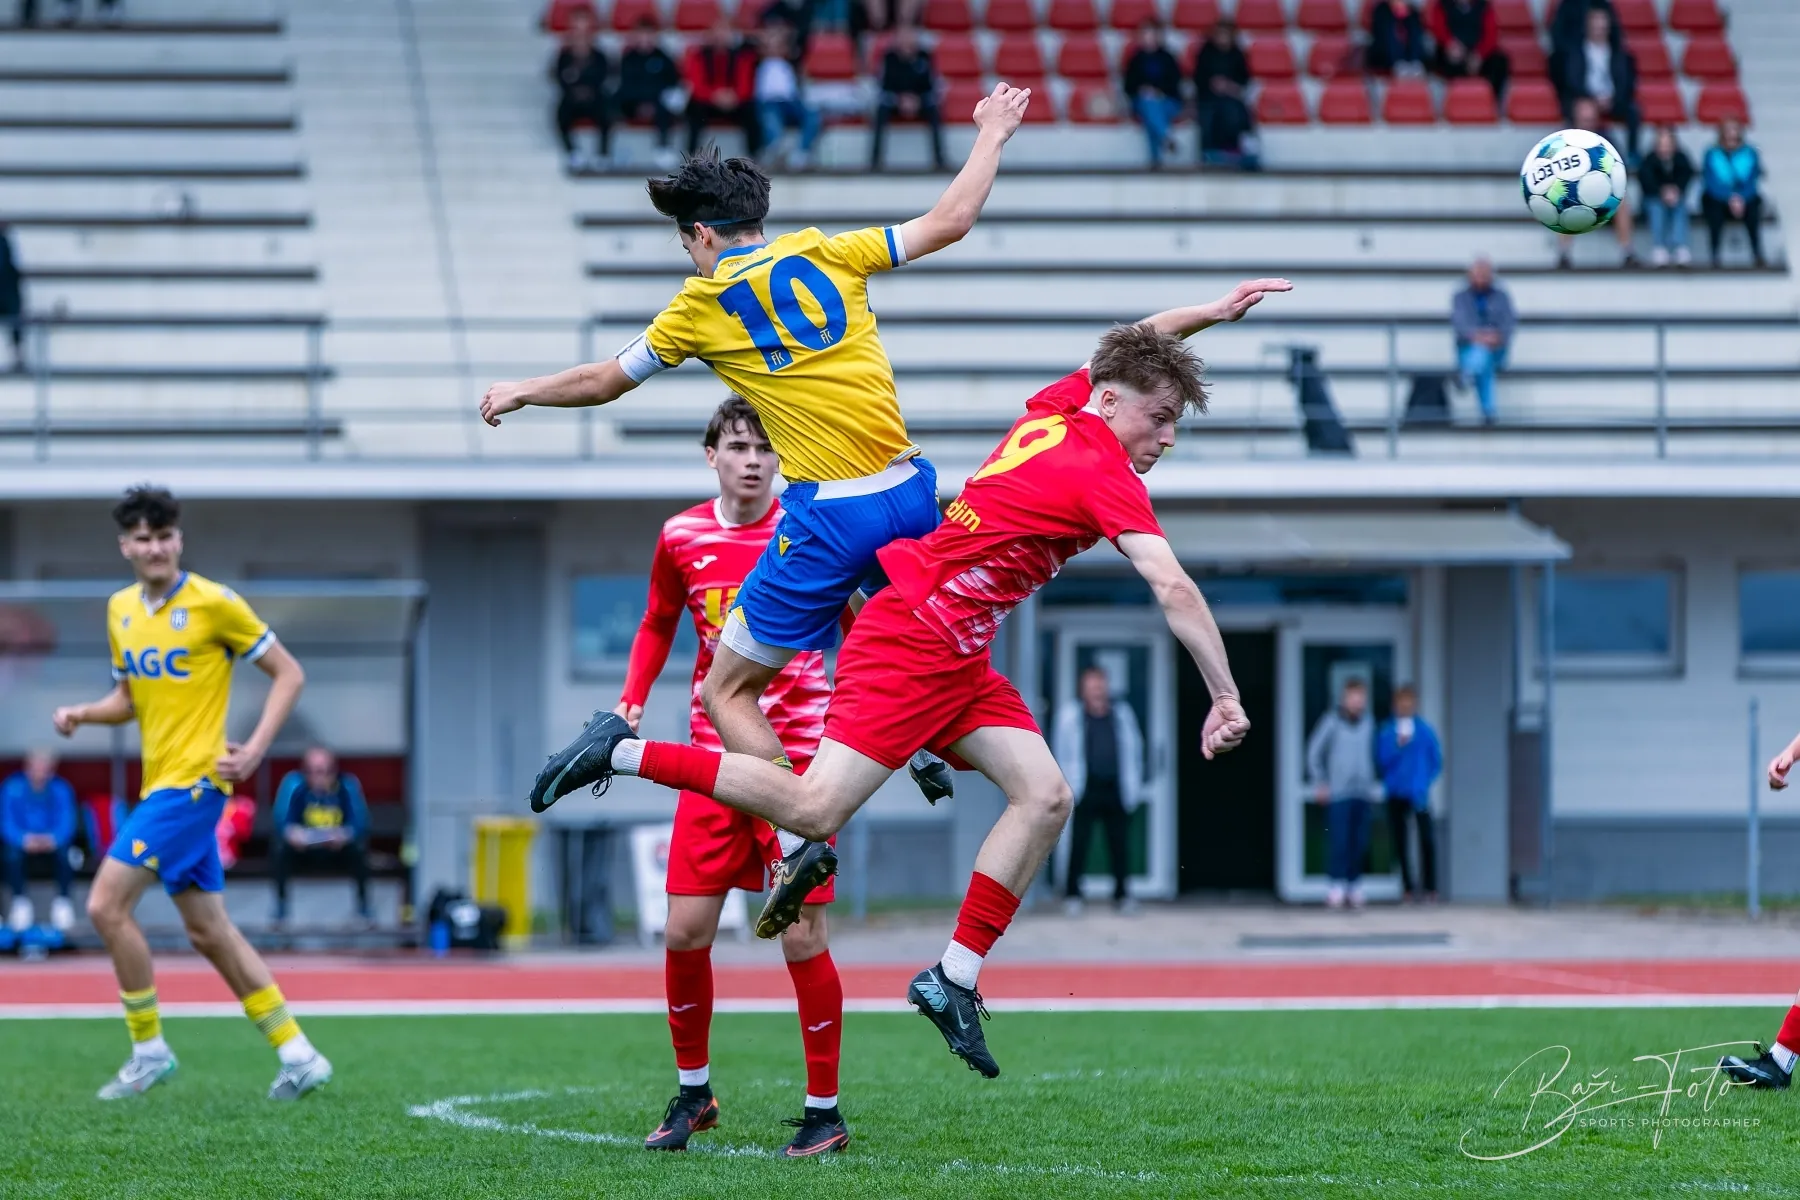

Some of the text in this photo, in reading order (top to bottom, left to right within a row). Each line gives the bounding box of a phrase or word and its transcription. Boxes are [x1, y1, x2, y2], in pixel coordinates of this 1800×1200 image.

[1532, 154, 1582, 186] SELECT
[716, 255, 848, 373] 10
[972, 414, 1068, 482] 9
[124, 647, 190, 678] AGC
